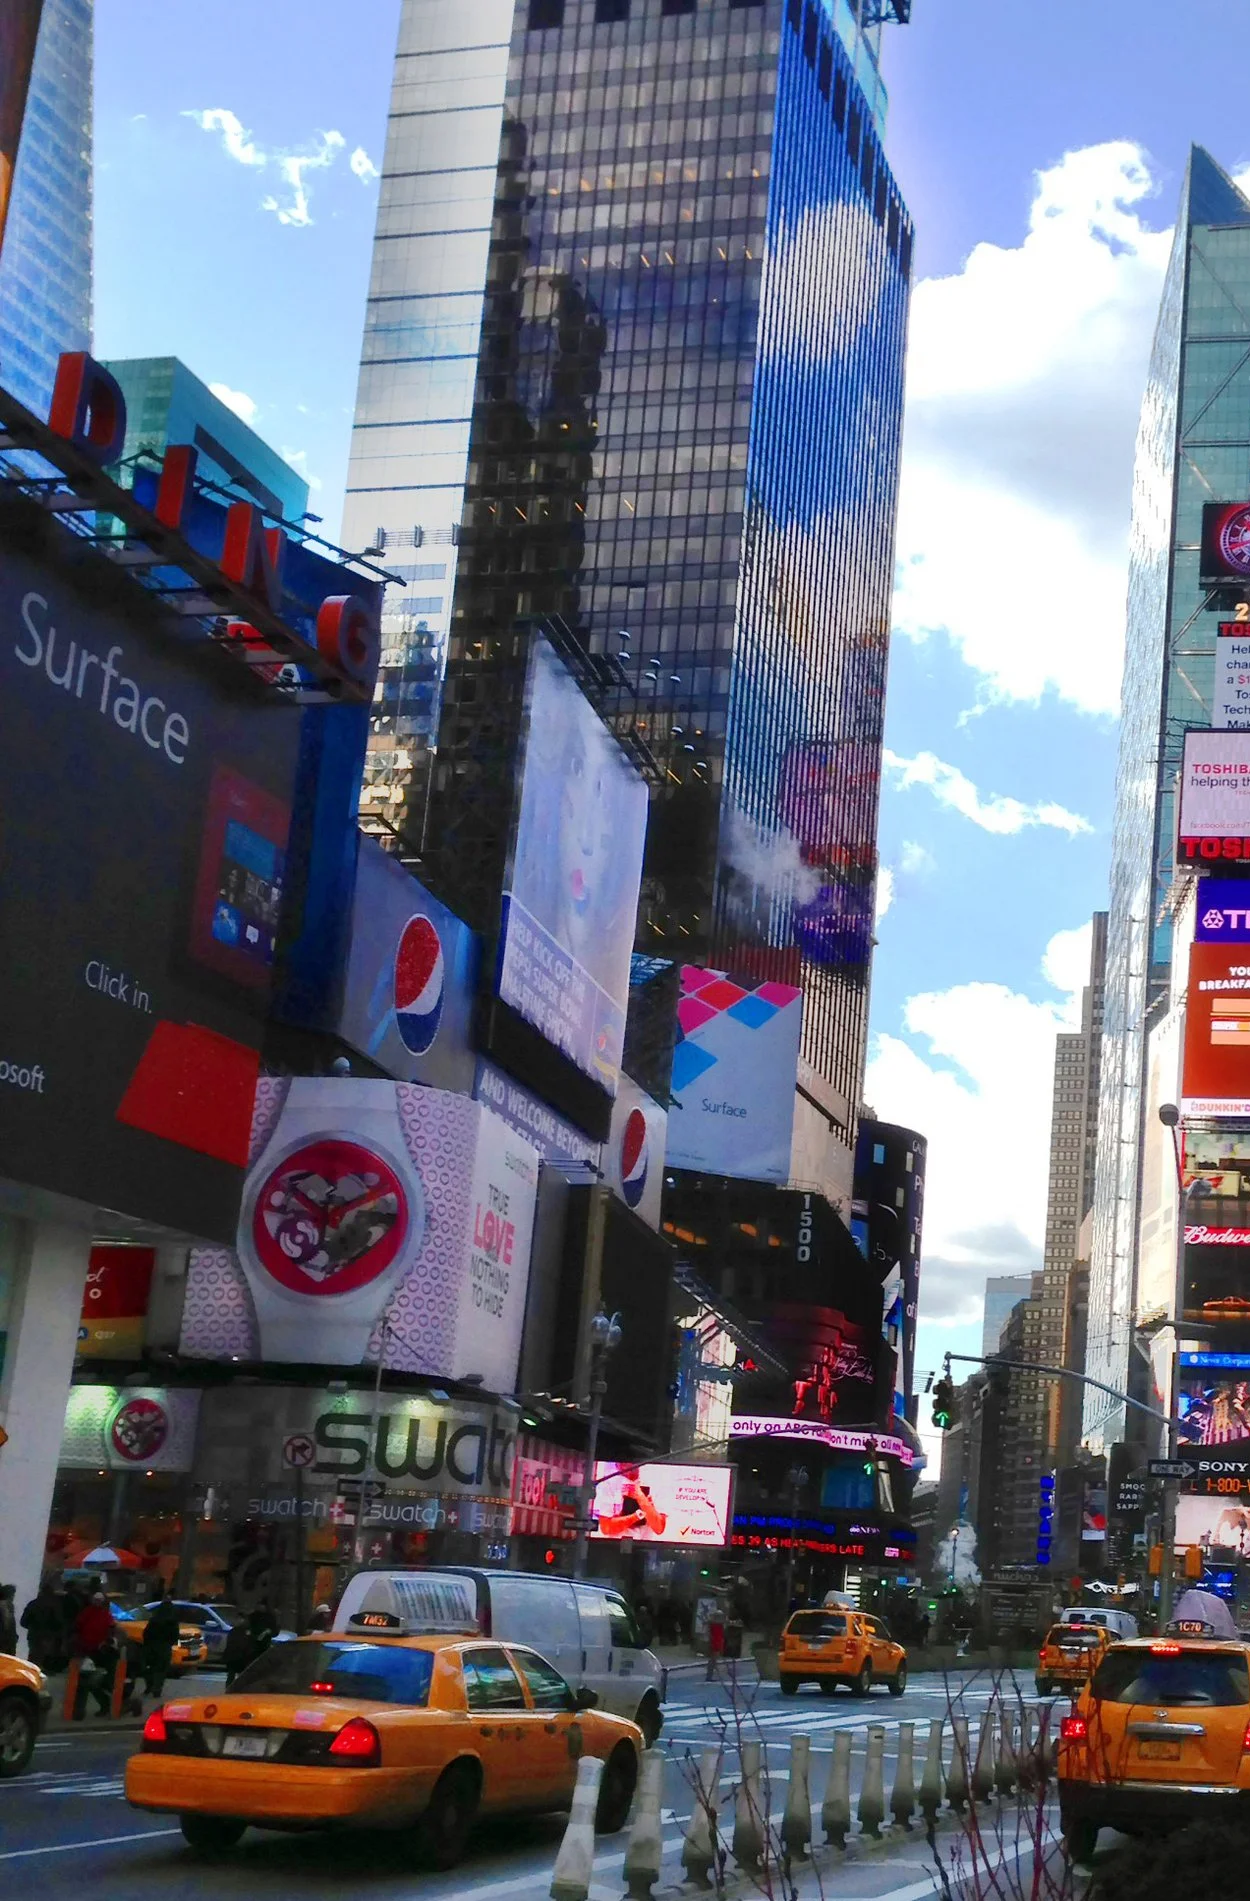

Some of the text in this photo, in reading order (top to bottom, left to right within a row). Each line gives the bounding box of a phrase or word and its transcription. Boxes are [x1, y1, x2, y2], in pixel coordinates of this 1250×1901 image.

[14, 591, 189, 765] Surface
[1191, 777, 1238, 789] helping
[85, 961, 152, 1014] Click in.
[701, 1098, 748, 1118] Surface
[473, 1202, 515, 1266] LOVE
[797, 1194, 814, 1262] 1500
[470, 1253, 509, 1295] NOTHING
[733, 1421, 761, 1438] only
[764, 1423, 781, 1433] on
[785, 1423, 809, 1436] ABC
[1156, 1465, 1191, 1475] ONE WAY
[1199, 1461, 1249, 1472] SONY
[248, 1497, 327, 1518] swatch
[367, 1499, 447, 1524] swatch
[691, 1528, 715, 1536] Norton
[839, 1545, 865, 1556] LATE
[1178, 1621, 1202, 1631] 1C70
